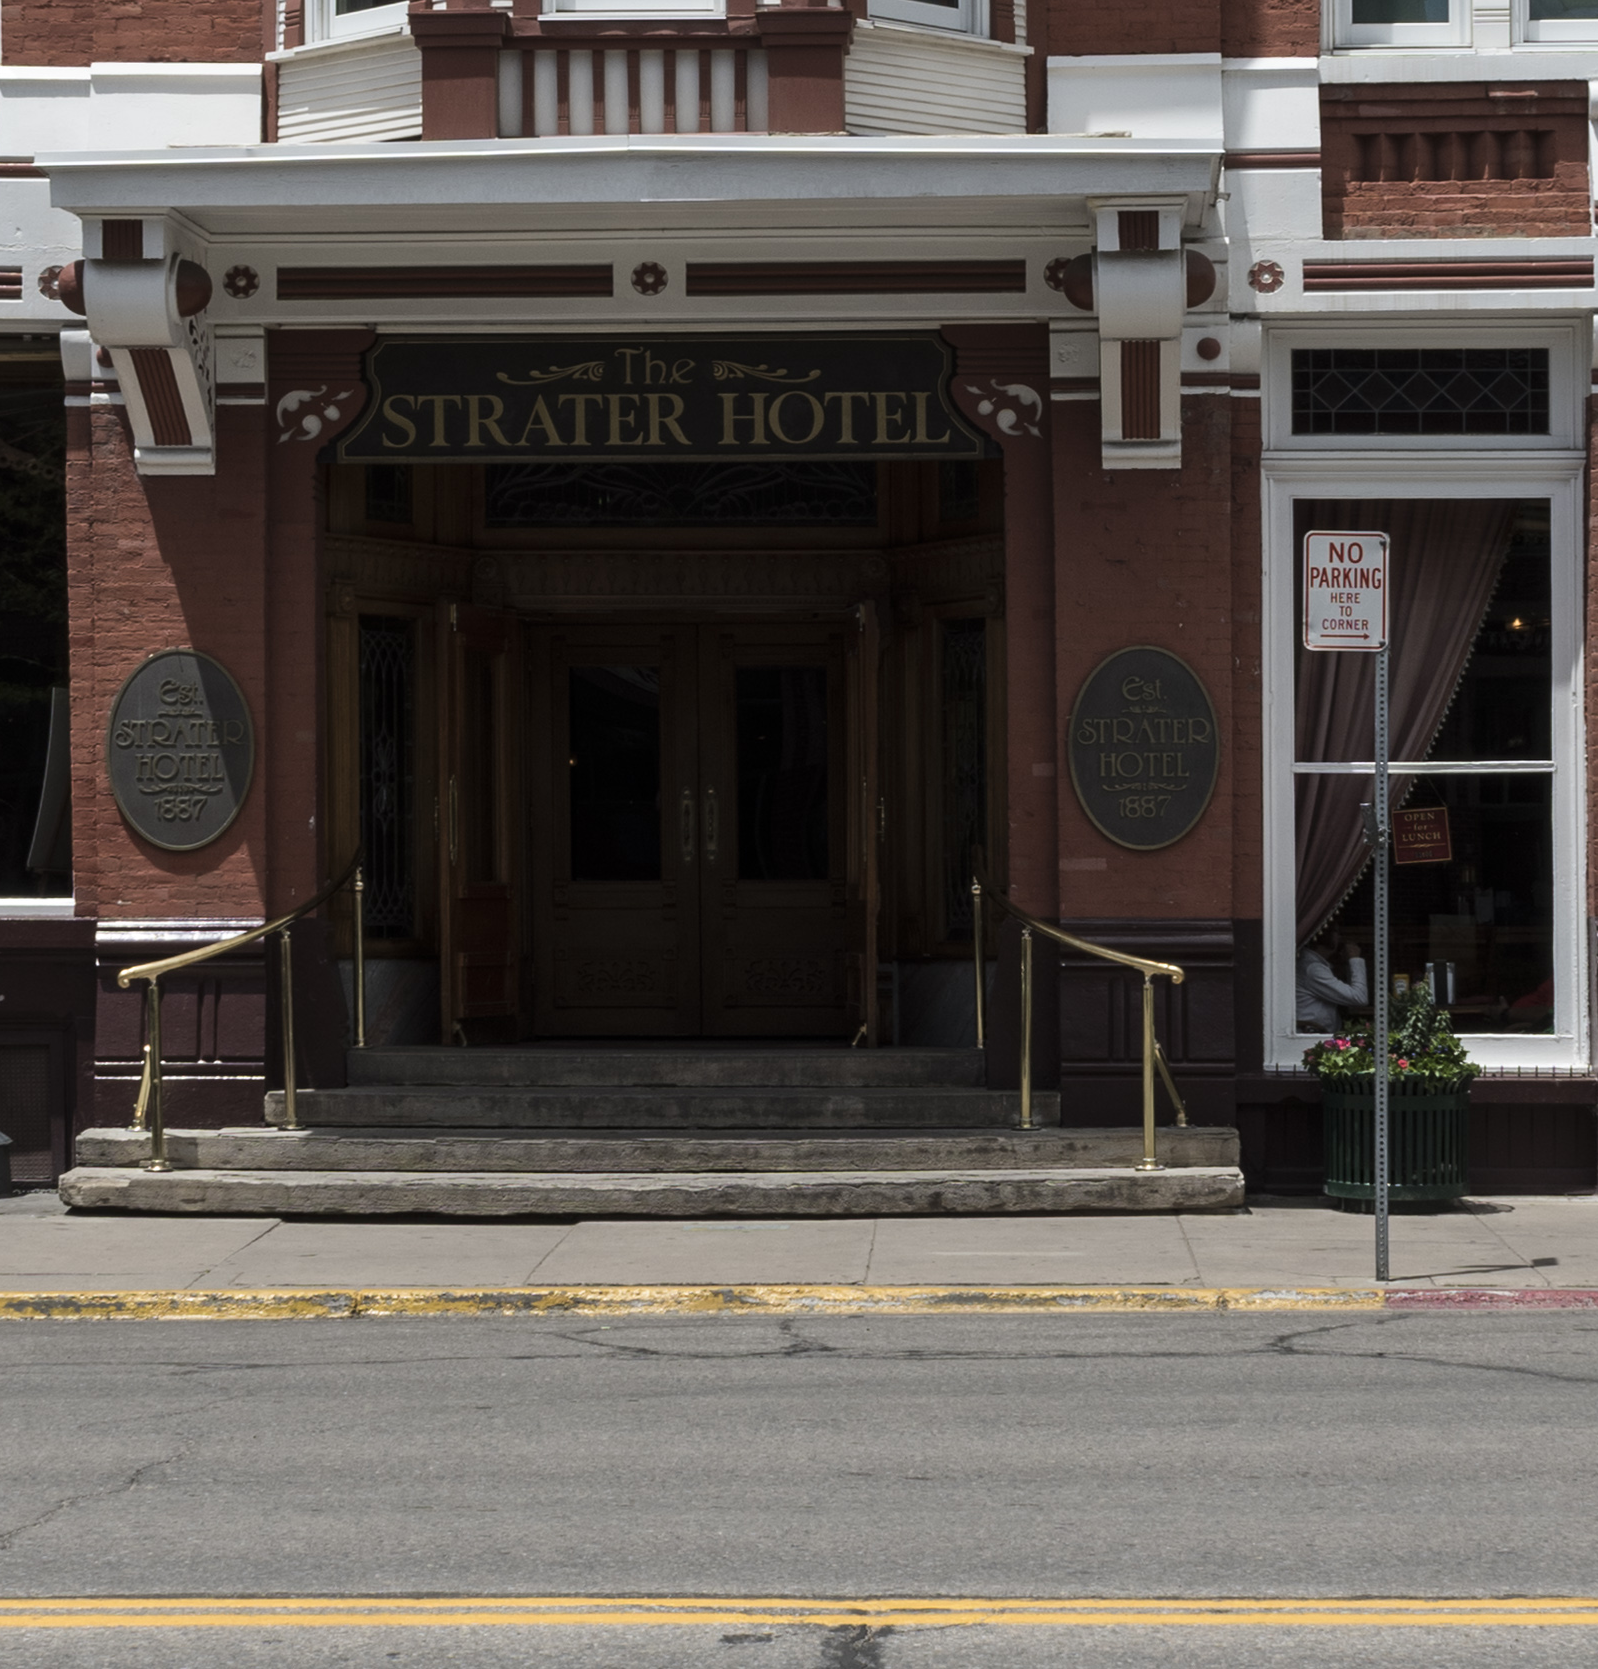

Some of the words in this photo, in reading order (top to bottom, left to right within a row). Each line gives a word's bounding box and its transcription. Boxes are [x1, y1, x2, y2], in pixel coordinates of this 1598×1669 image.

[614, 346, 696, 385] The
[381, 391, 693, 449] STRATER
[718, 389, 952, 447] HOTEL
[1328, 541, 1364, 564] NO
[1309, 566, 1383, 590] PARKING
[1330, 592, 1361, 604] HERE
[1339, 605, 1353, 617] TO
[1321, 618, 1369, 631] CORNER
[159, 679, 203, 705] Est.
[1122, 676, 1167, 701] Est.
[114, 719, 244, 748] STRATER
[1077, 718, 1212, 745] STRATER
[135, 753, 225, 782] HOTEL
[1099, 751, 1190, 778] HOTEL
[153, 796, 208, 821] 1887
[1118, 796, 1172, 818] 1887
[1404, 812, 1435, 821] OPEN
[1402, 831, 1441, 842] LUNCH
[1413, 823, 1428, 831] for
